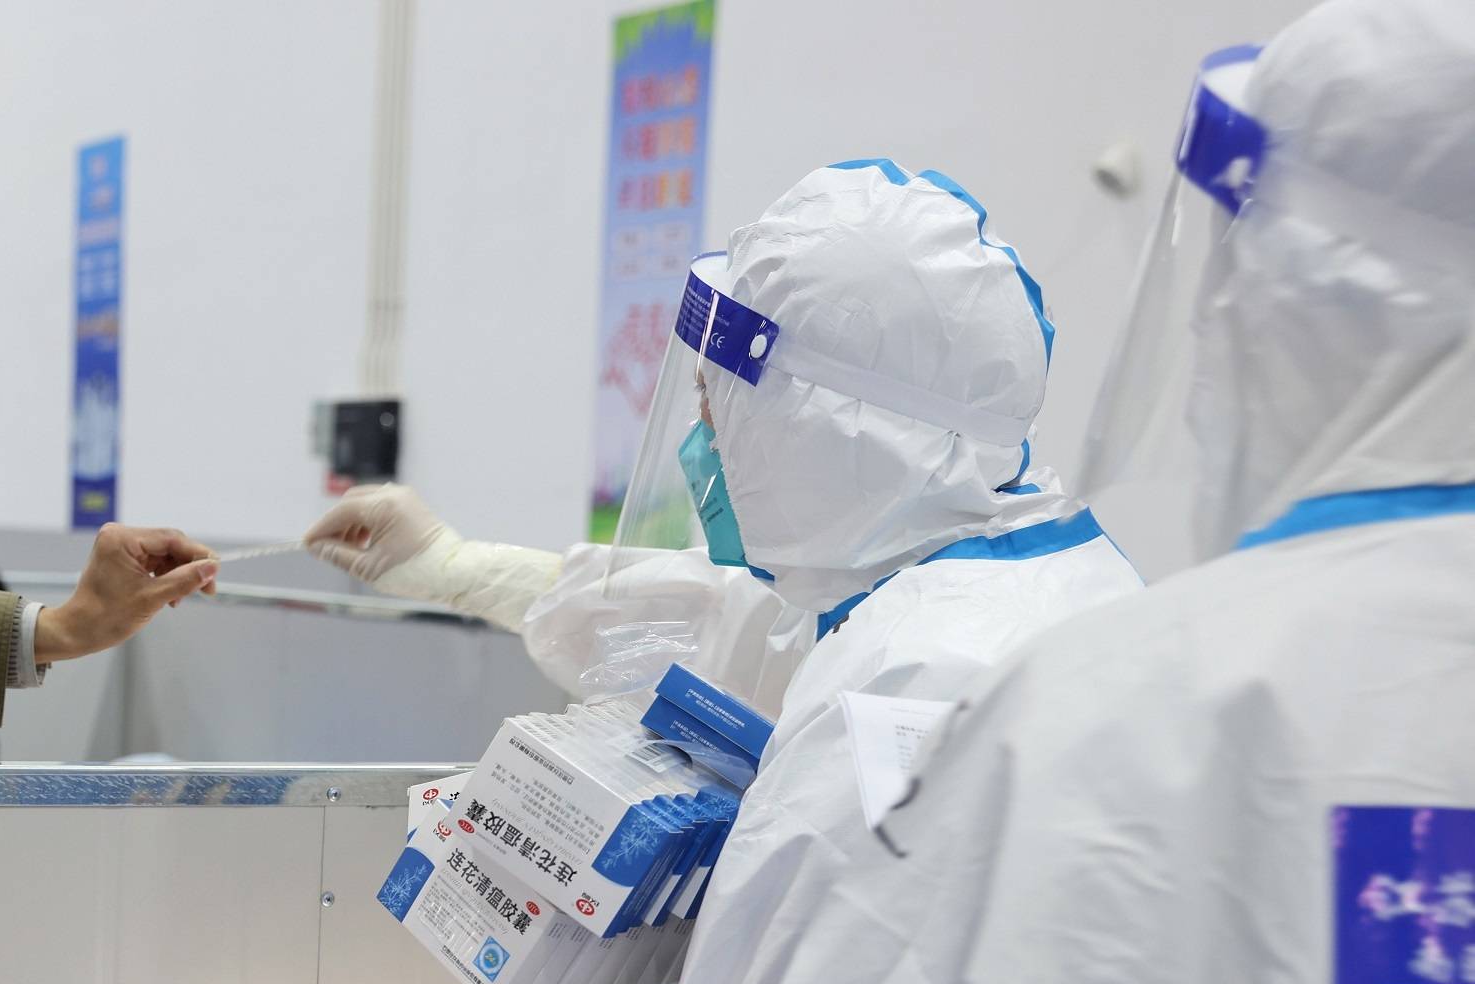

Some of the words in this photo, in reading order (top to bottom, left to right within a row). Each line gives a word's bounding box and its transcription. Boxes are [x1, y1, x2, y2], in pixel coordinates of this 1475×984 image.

[465, 799, 577, 887] 连花清瘟胶囊
[447, 848, 532, 935] 连花清瘟胶囊
